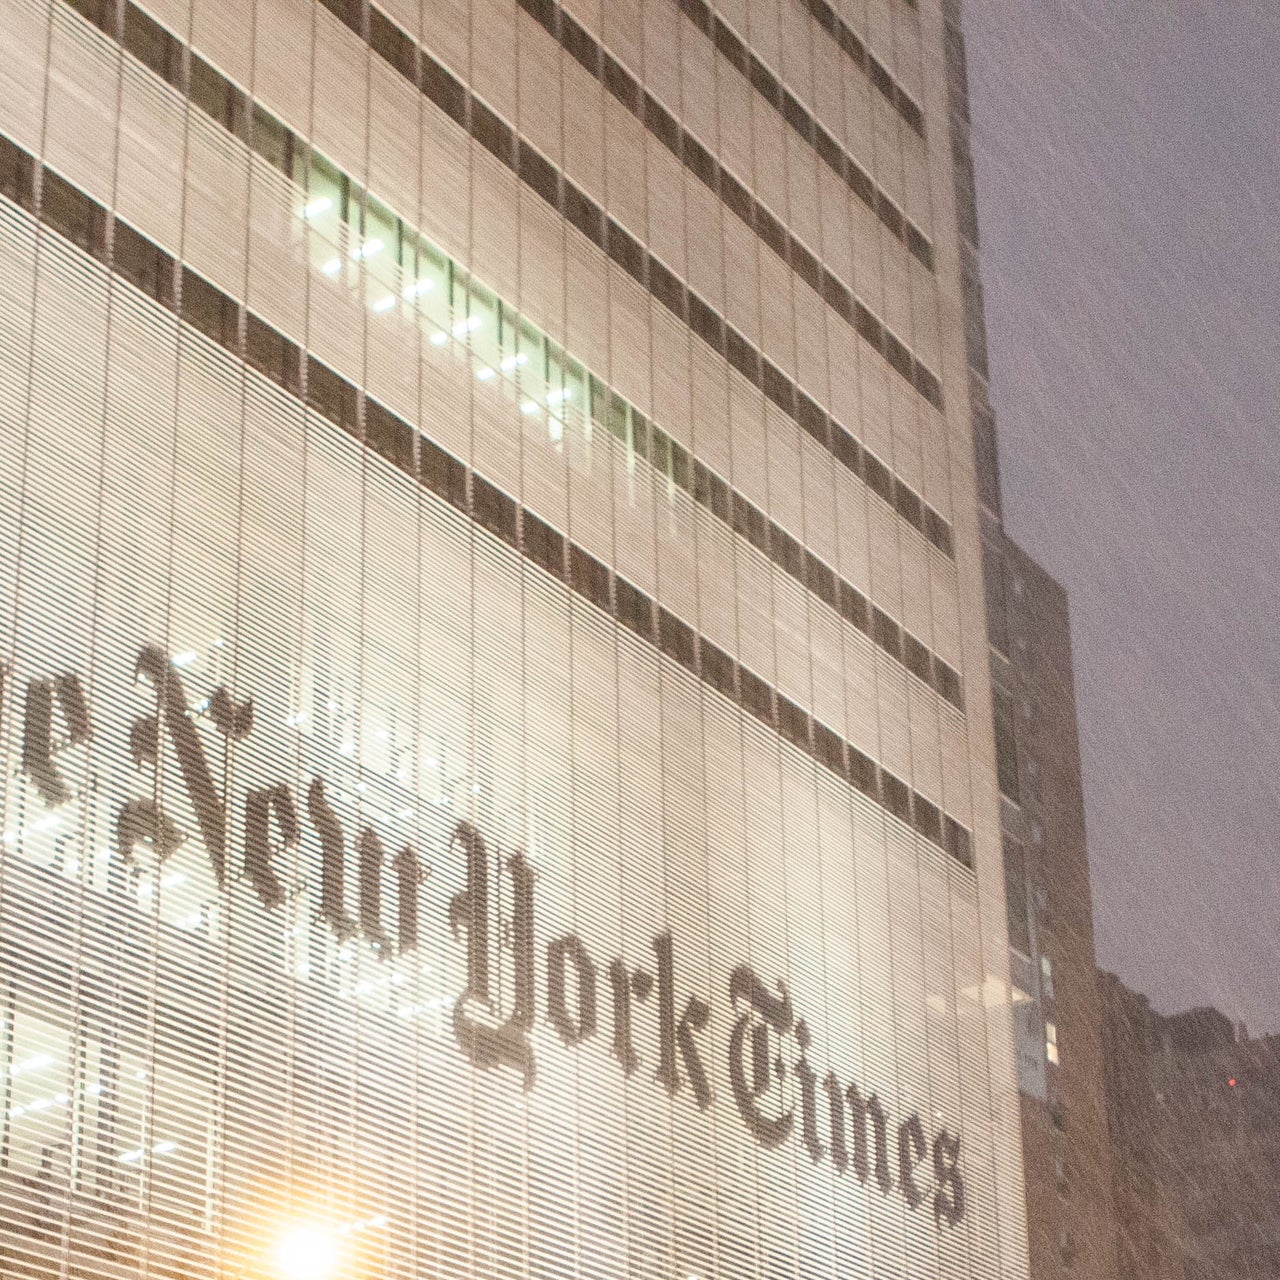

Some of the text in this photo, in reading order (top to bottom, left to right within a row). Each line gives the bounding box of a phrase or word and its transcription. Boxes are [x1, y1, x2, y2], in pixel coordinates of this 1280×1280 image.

[119, 642, 431, 961] New
[448, 820, 715, 1113] York
[727, 962, 967, 1228] Times
